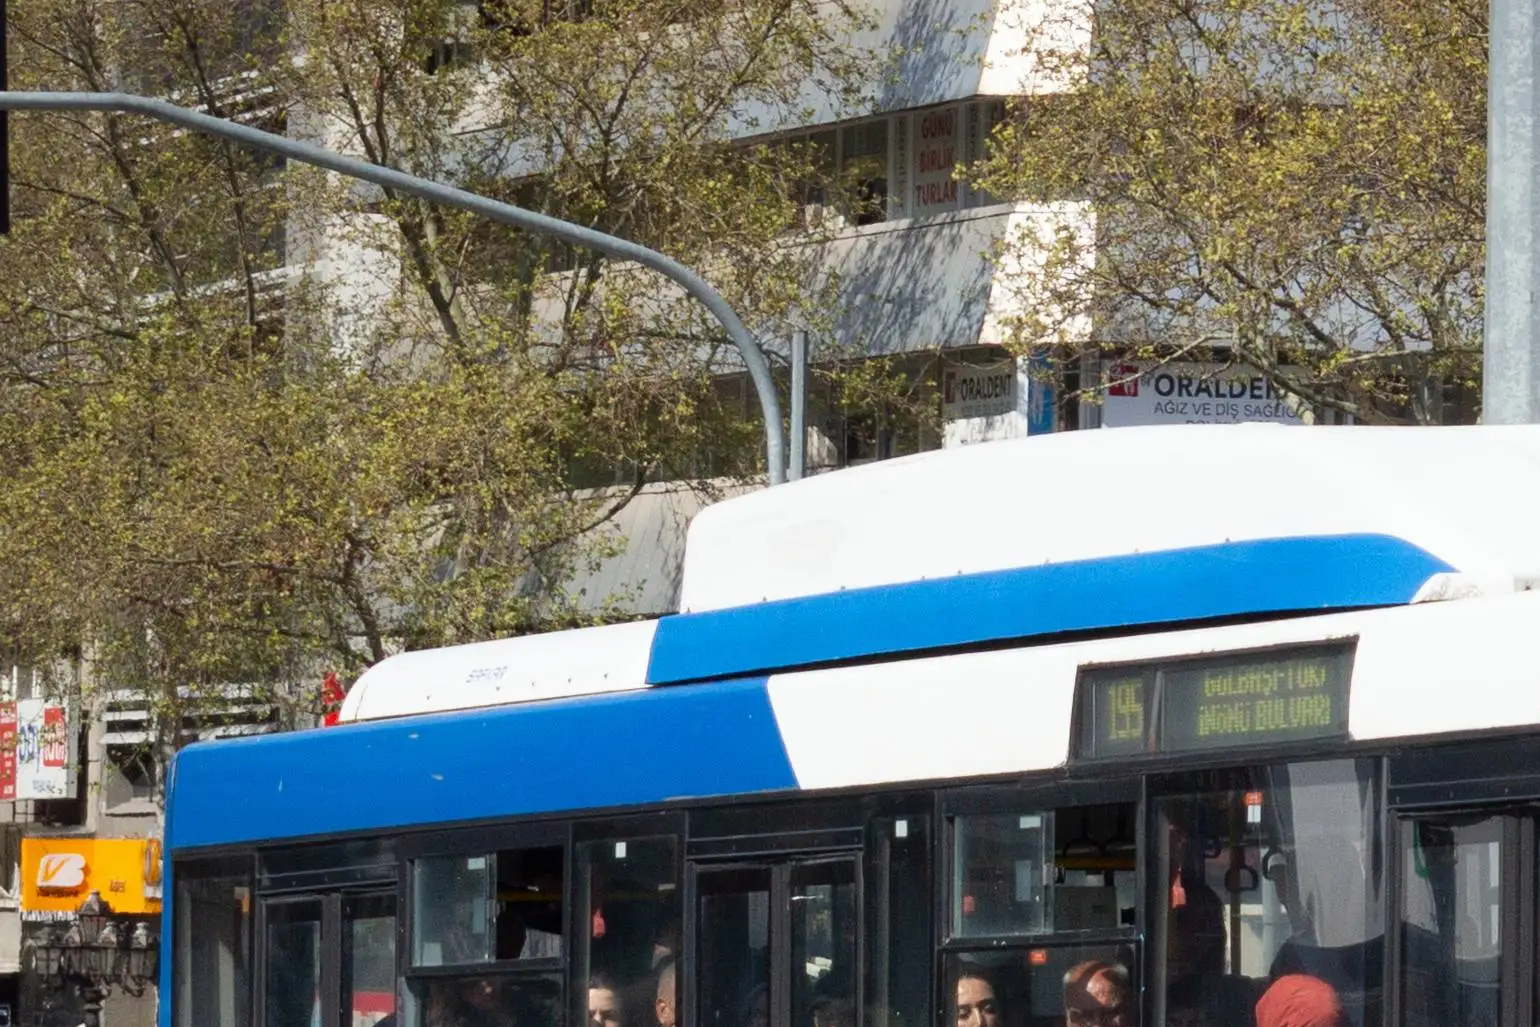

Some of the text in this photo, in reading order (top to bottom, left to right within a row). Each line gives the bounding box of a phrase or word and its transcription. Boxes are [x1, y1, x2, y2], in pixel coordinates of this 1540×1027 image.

[961, 374, 1012, 401] ORALDENT
[1154, 401, 1188, 415] AĞIZ
[1194, 403, 1211, 416] VE
[1109, 678, 1144, 740] 195
